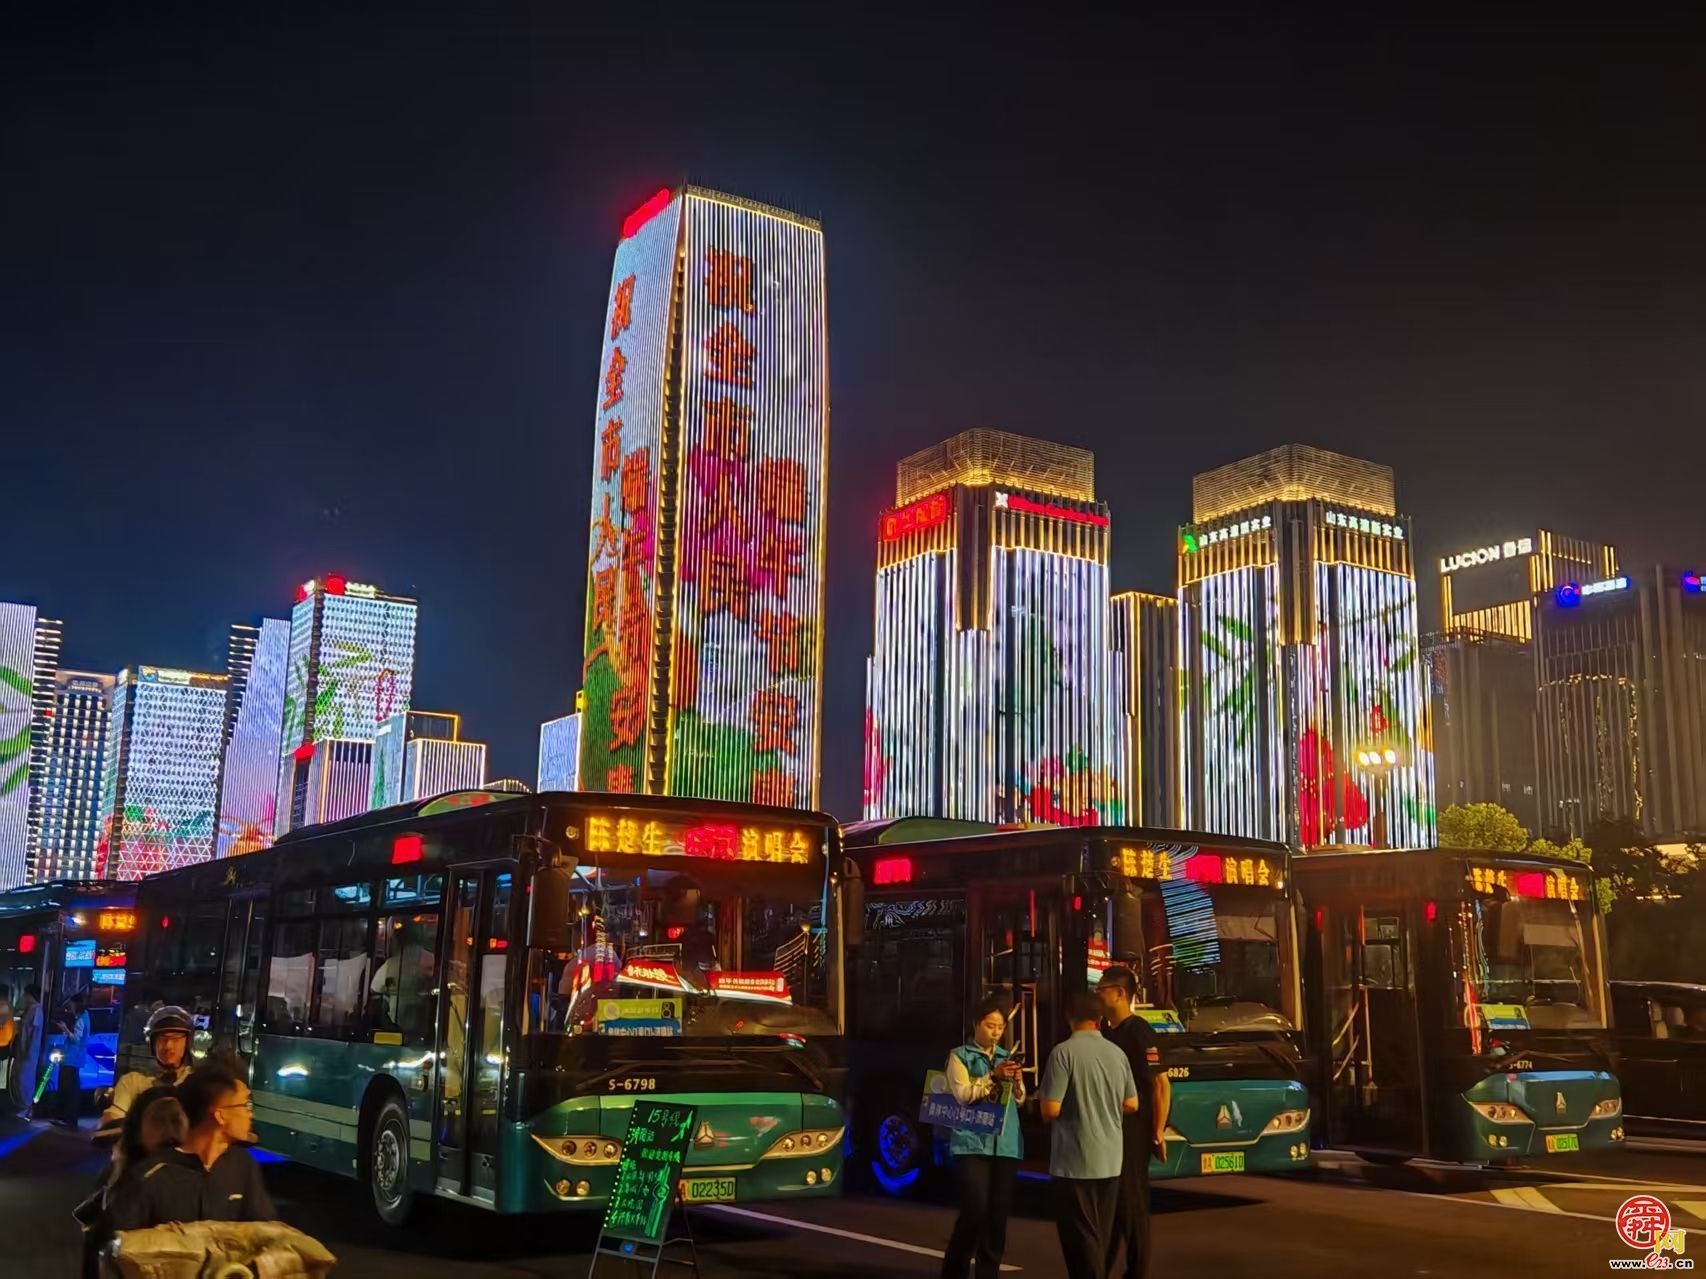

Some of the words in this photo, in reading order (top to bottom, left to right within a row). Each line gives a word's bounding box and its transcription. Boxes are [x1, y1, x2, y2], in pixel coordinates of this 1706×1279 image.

[699, 245, 757, 620] 祝全市人民
[1440, 545, 1500, 573] LUCION
[1120, 848, 1173, 880] 陈楚生
[1225, 857, 1271, 886] 演唱会
[608, 1078, 656, 1091] S-6798
